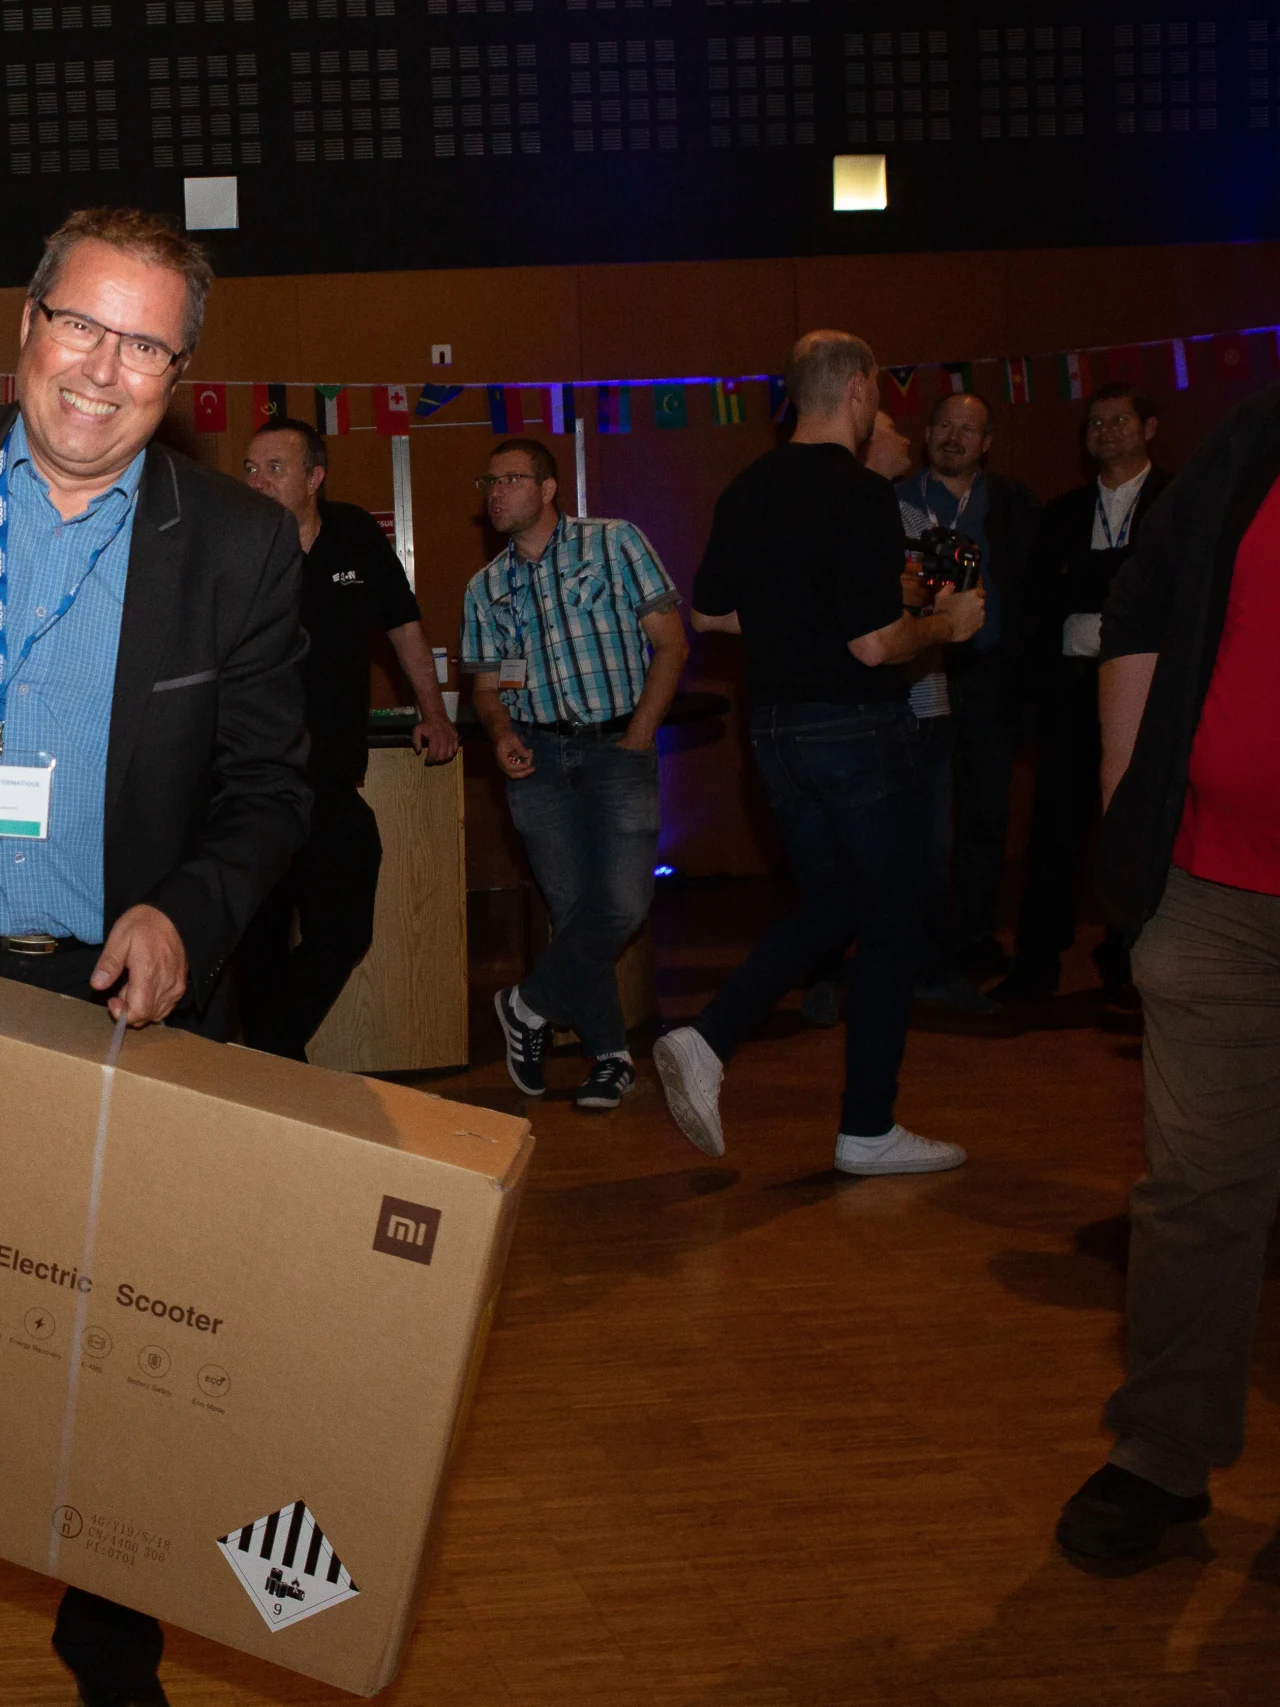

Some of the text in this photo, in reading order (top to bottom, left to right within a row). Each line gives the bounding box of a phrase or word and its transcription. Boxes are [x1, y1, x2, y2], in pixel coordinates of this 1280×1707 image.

[115, 1283, 225, 1336] Scooter
[8, 1336, 63, 1361] Energy Recovery
[143, 1545, 166, 1563] 306
[272, 1602, 284, 1617] 9
